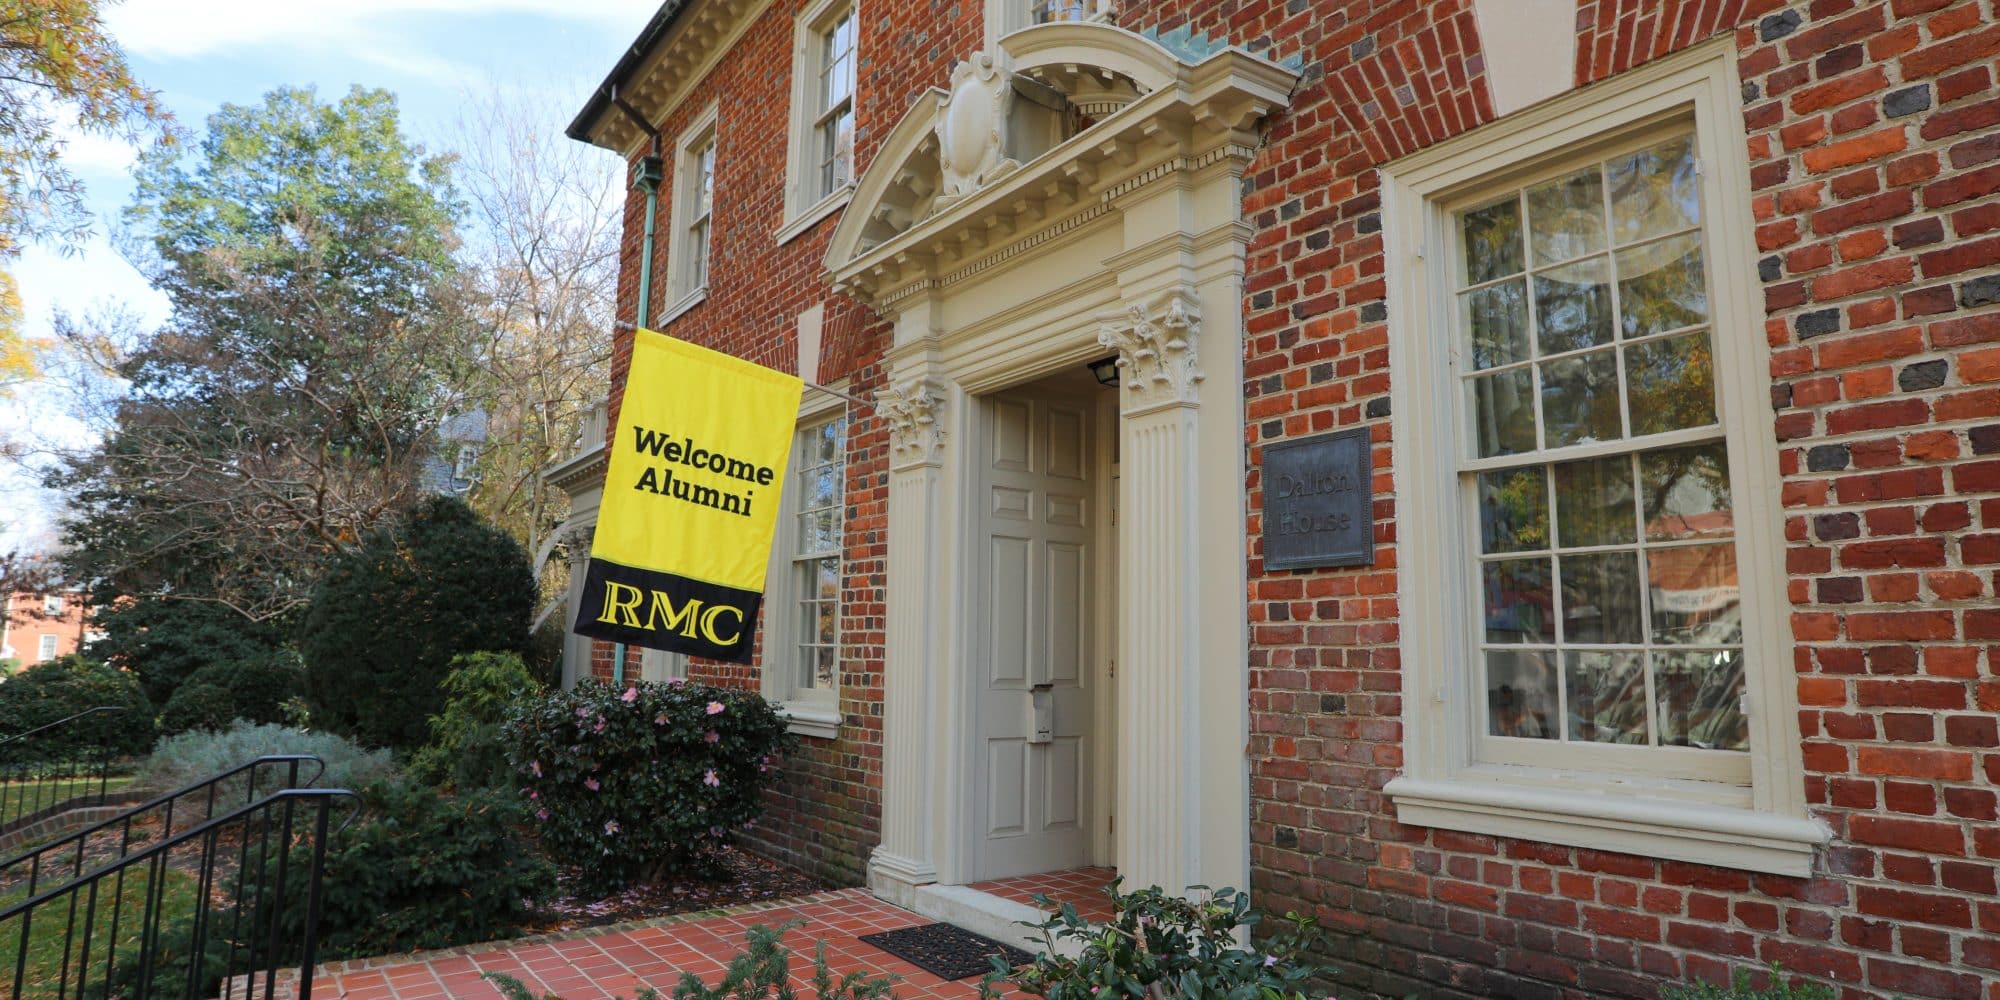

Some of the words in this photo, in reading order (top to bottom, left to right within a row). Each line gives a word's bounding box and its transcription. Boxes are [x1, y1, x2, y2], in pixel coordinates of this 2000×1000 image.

[633, 426, 774, 486] Welcome
[634, 467, 754, 517] Alumni
[1277, 470, 1354, 499] Dalton
[1279, 510, 1351, 536] House
[597, 581, 743, 646] RMC
